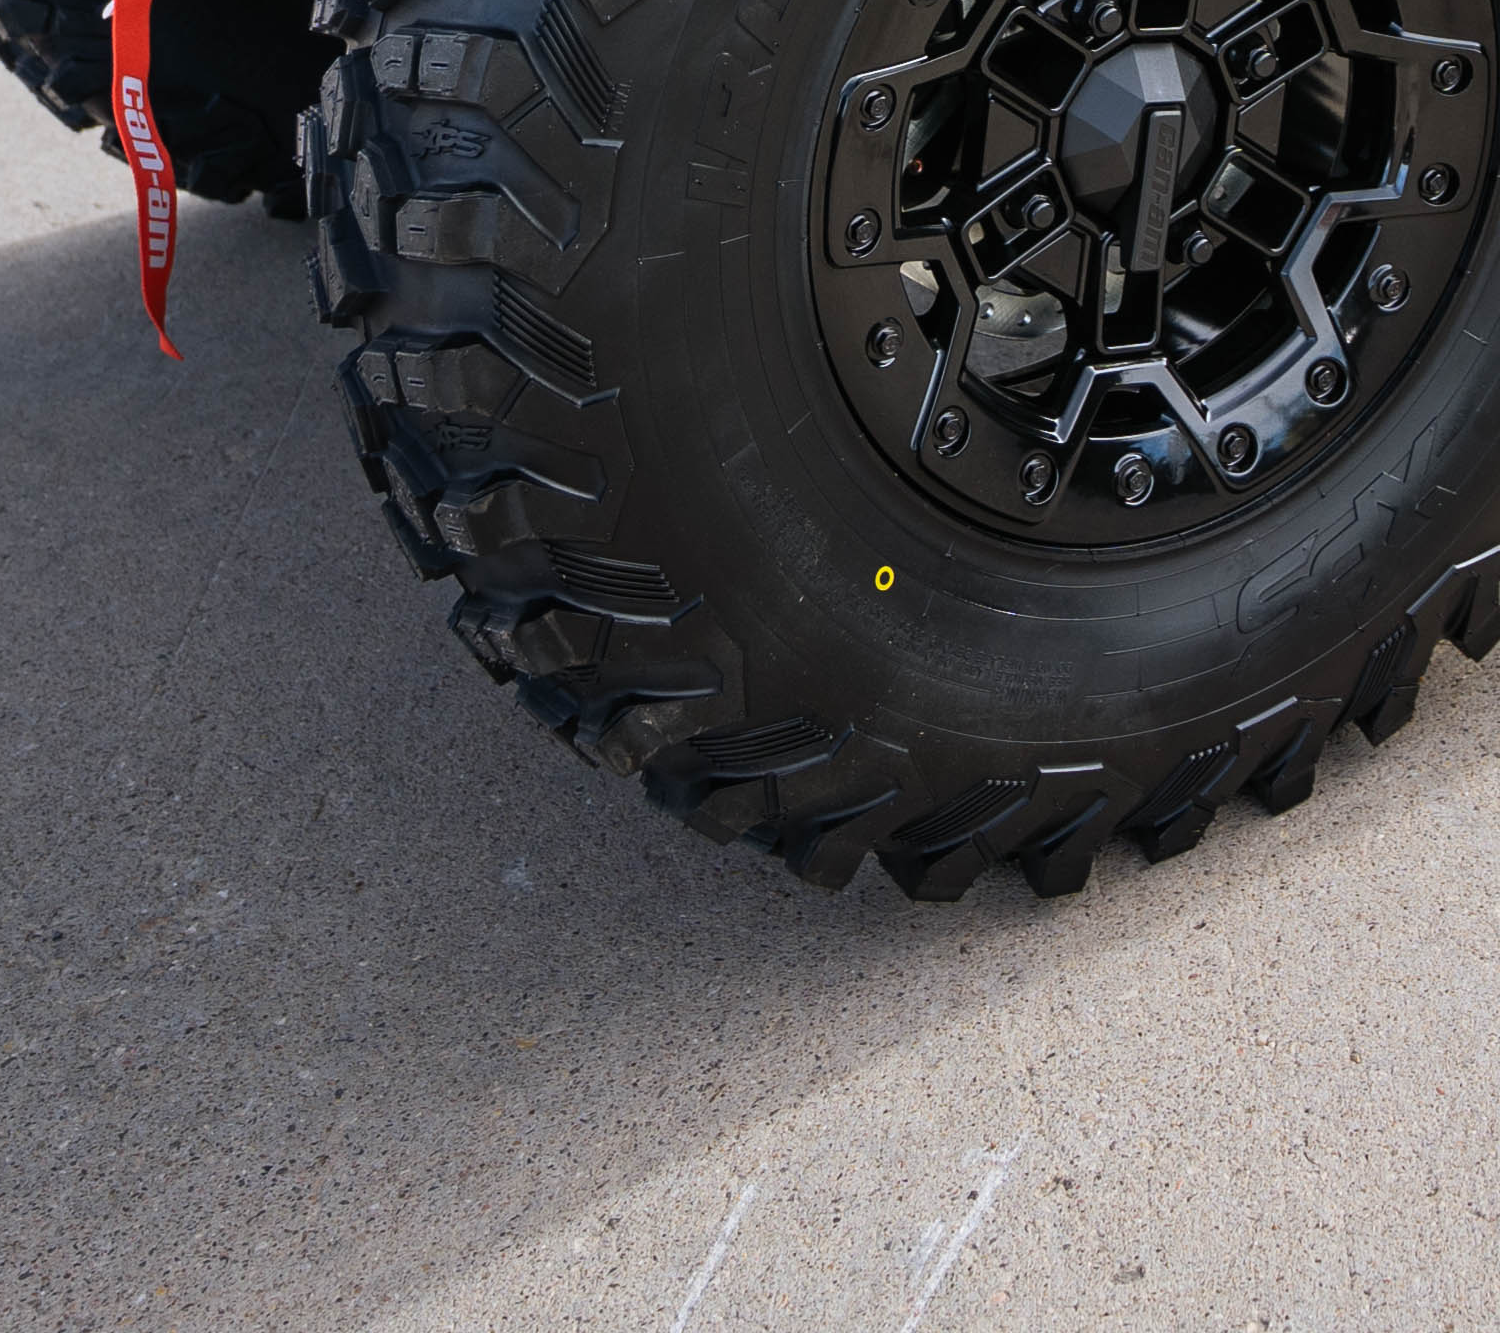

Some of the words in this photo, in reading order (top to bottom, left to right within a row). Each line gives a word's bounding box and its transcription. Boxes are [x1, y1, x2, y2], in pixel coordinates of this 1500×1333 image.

[121, 75, 168, 270] can-am
[1134, 123, 1178, 266] can-am
[1233, 415, 1460, 655] XPS
